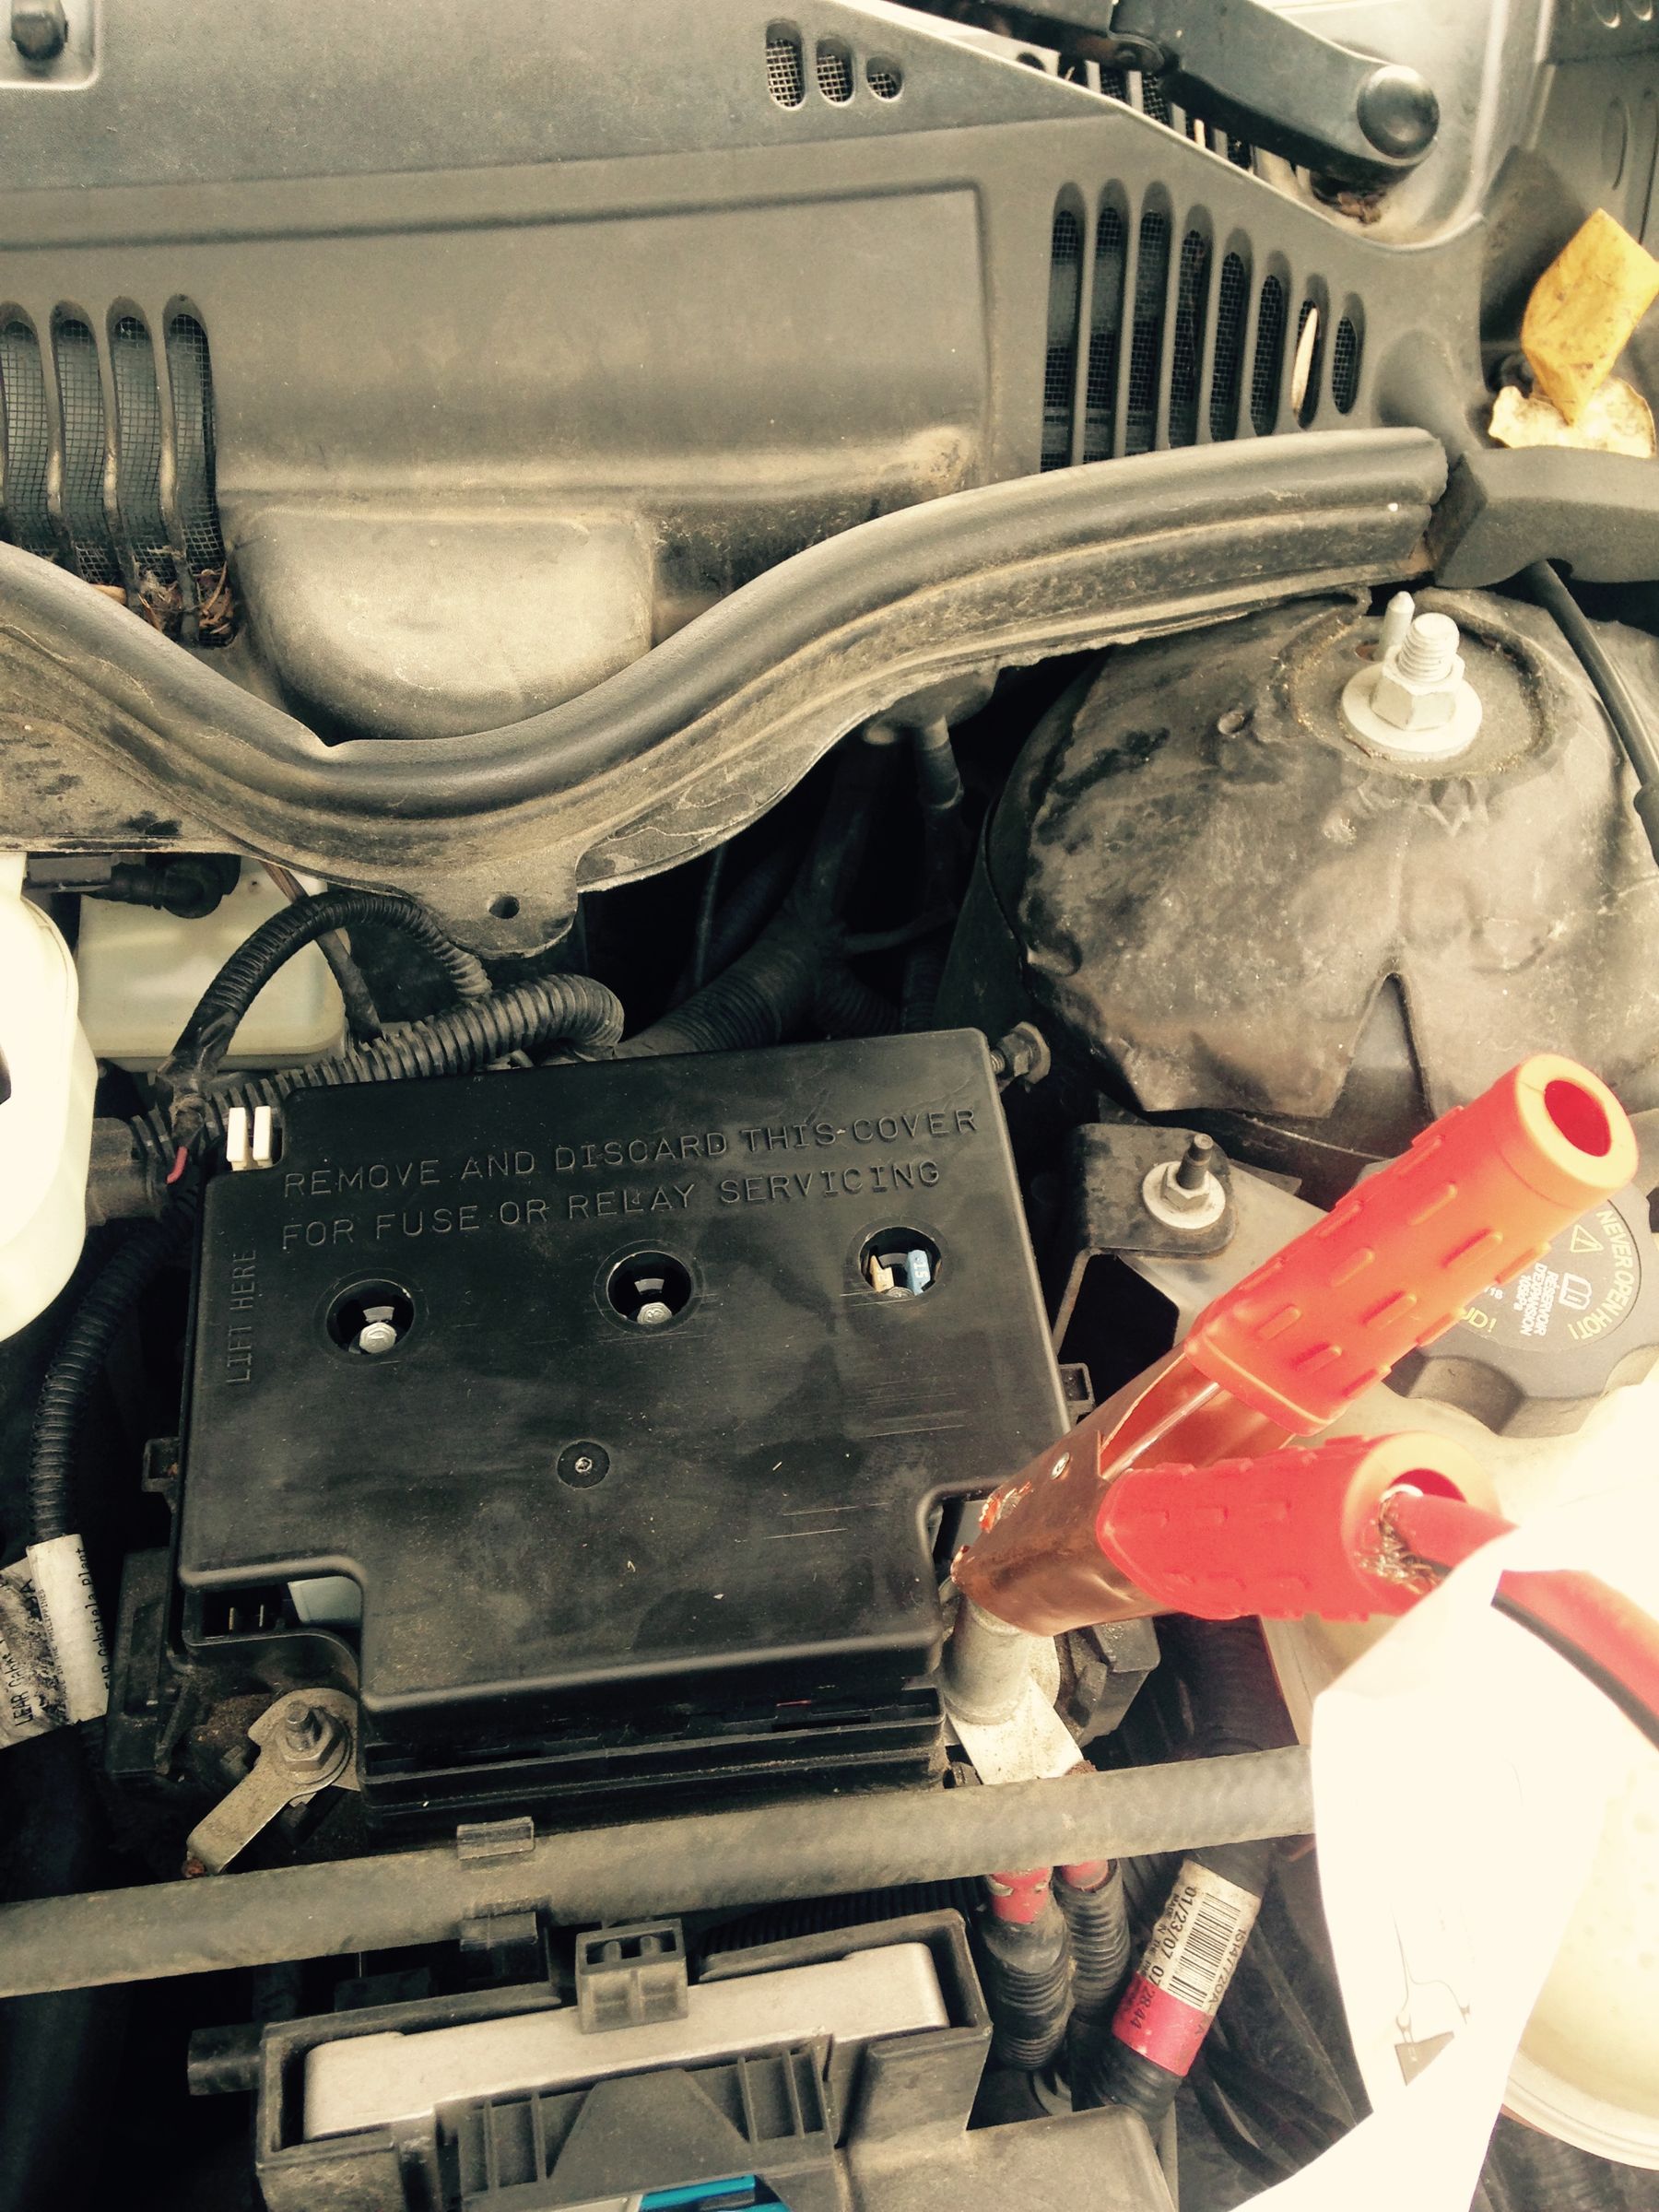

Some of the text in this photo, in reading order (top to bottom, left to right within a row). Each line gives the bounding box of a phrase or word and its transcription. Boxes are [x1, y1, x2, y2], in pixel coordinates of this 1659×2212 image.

[285, 1109, 978, 1198] REMOVE AND DISCARD THIS COVER
[283, 1161, 941, 1251] FOR FUSE OR RELAY SERVICING
[1595, 1209, 1634, 1269] NEVER
[226, 1250, 256, 1386] LIFT HERE
[1604, 1269, 1635, 1317] OPEN
[74, 1547, 93, 1587] Plant
[10, 1688, 34, 1727] LEAR
[1157, 1923, 1169, 1935] IN
[1161, 1886, 1197, 1960] 01/23/07
